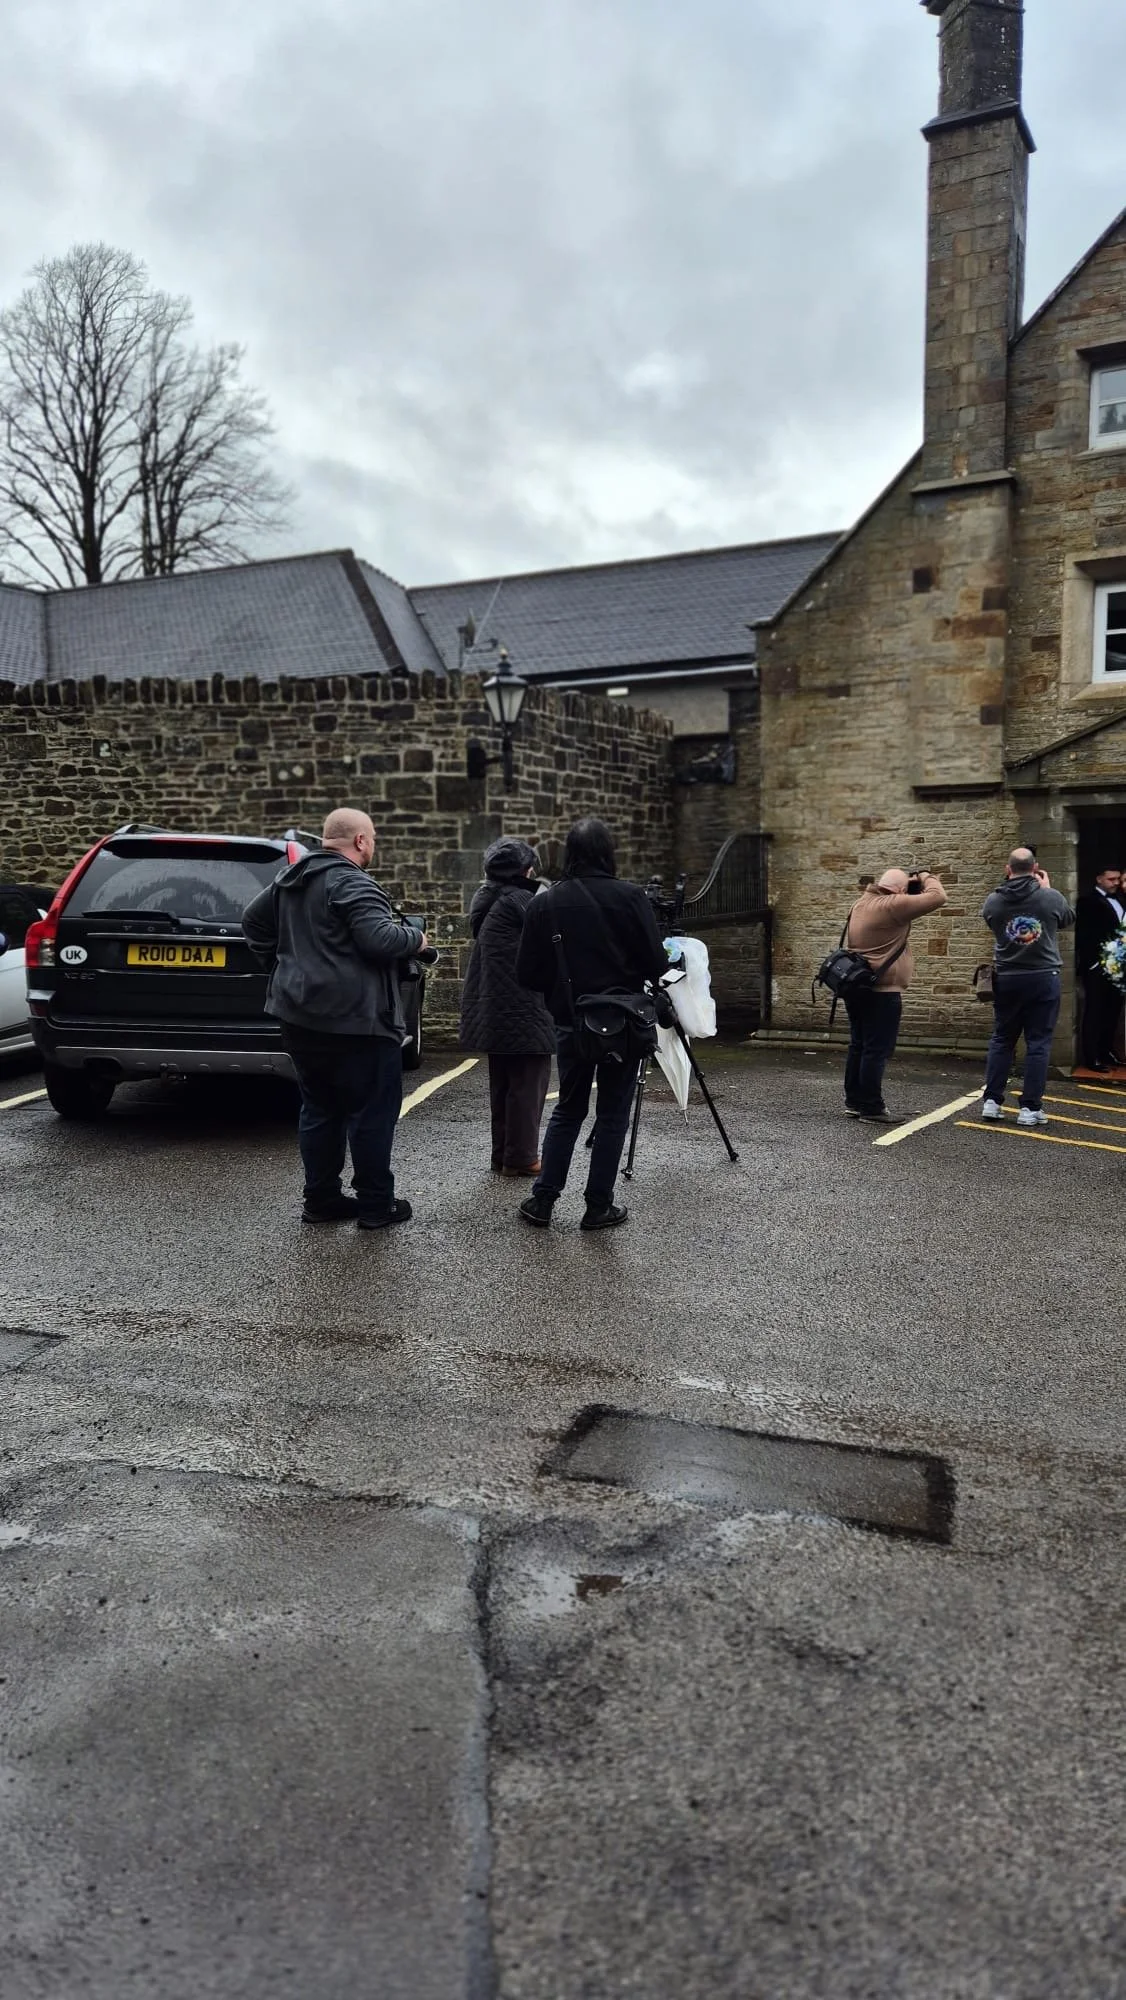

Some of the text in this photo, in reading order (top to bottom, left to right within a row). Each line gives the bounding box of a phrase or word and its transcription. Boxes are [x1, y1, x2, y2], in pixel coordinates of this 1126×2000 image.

[122, 925, 228, 935] VOLVO
[65, 950, 82, 960] UK
[181, 947, 214, 963] DAA
